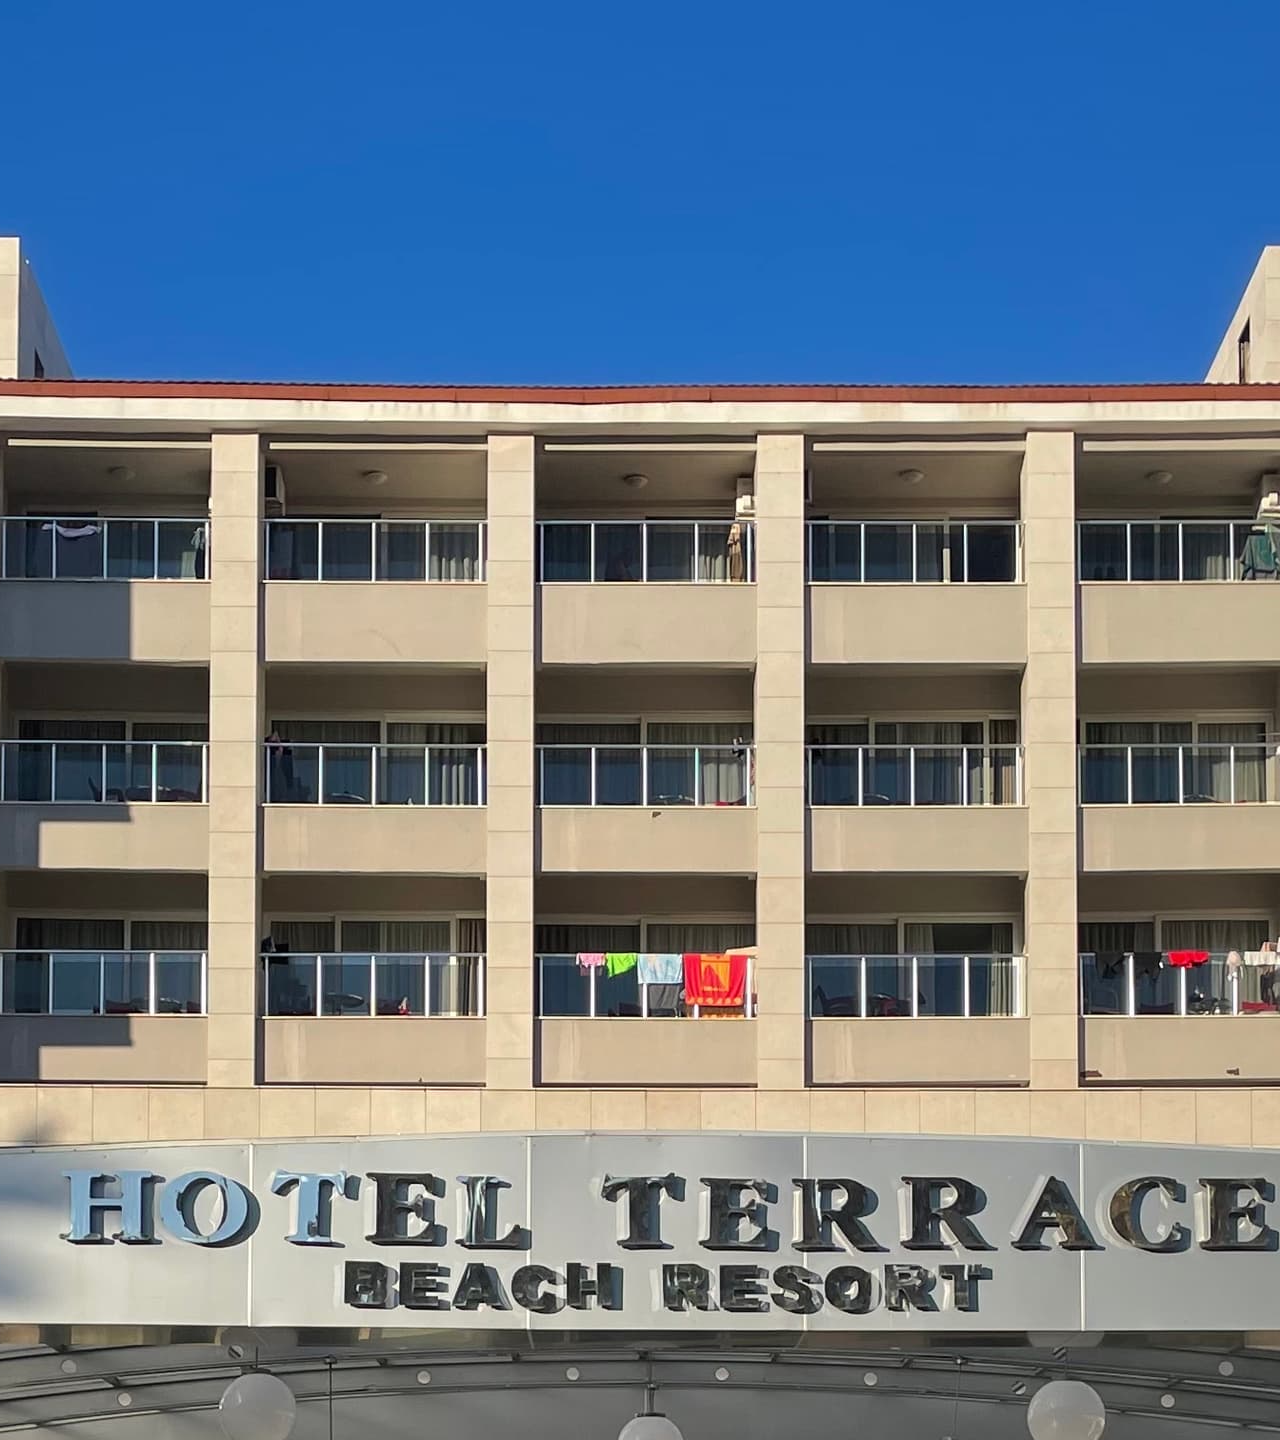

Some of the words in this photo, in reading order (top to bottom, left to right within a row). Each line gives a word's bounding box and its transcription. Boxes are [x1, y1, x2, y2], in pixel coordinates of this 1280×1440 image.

[59, 1168, 532, 1250] HOTEL
[601, 1173, 1280, 1253] TERRACE
[344, 1260, 623, 1315] BEACH
[661, 1262, 993, 1315] RESORT
